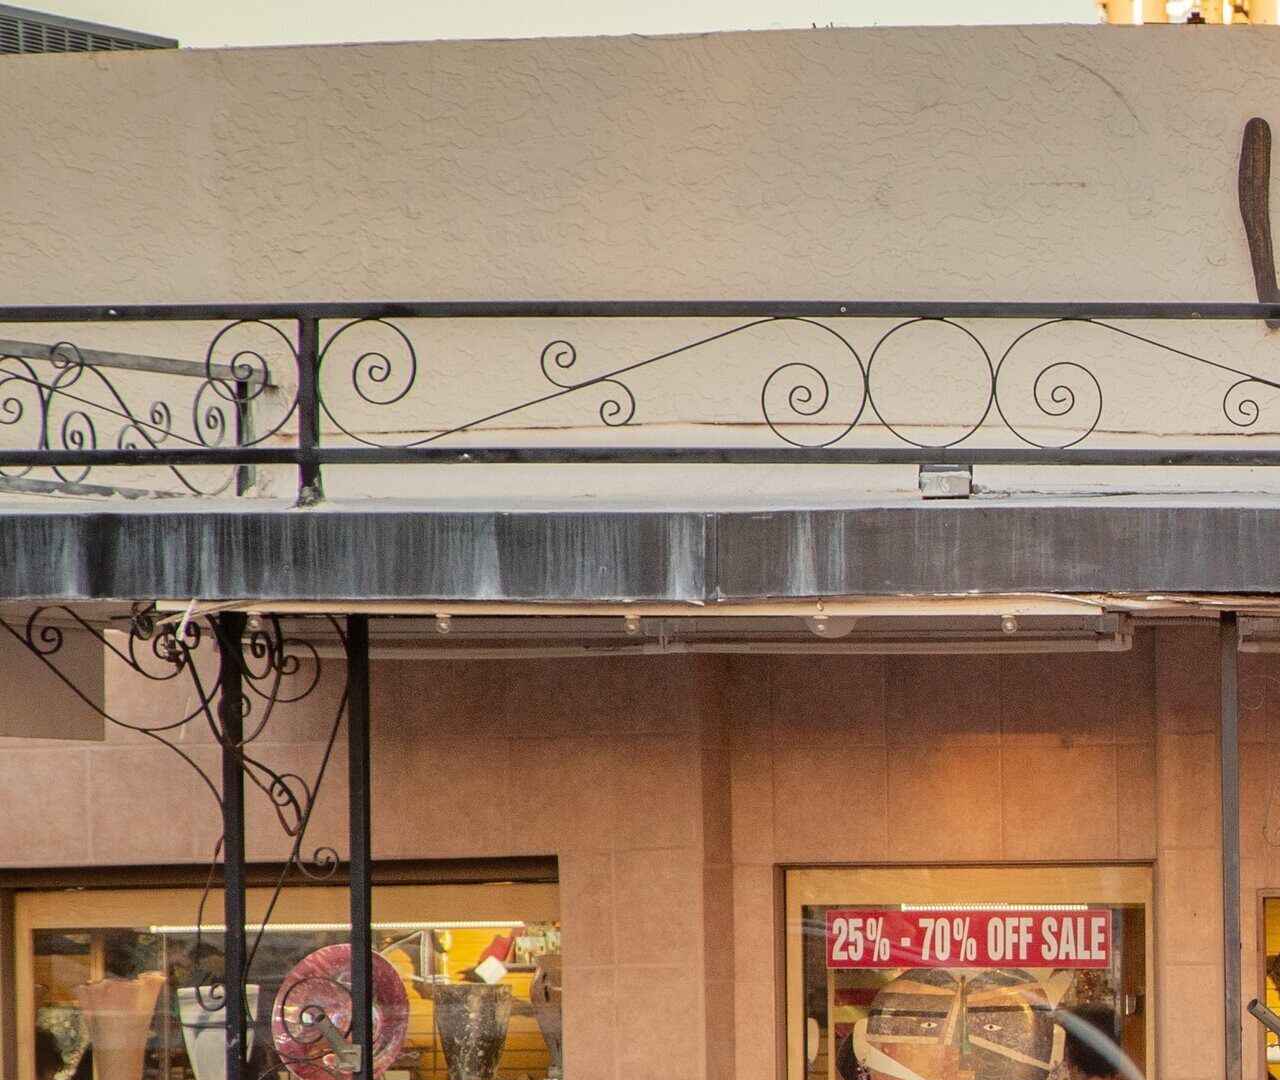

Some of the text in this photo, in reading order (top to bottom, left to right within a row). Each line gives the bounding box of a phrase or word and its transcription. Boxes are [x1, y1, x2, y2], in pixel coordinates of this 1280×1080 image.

[831, 917, 1106, 962] 25% - 70% OFF SALE
